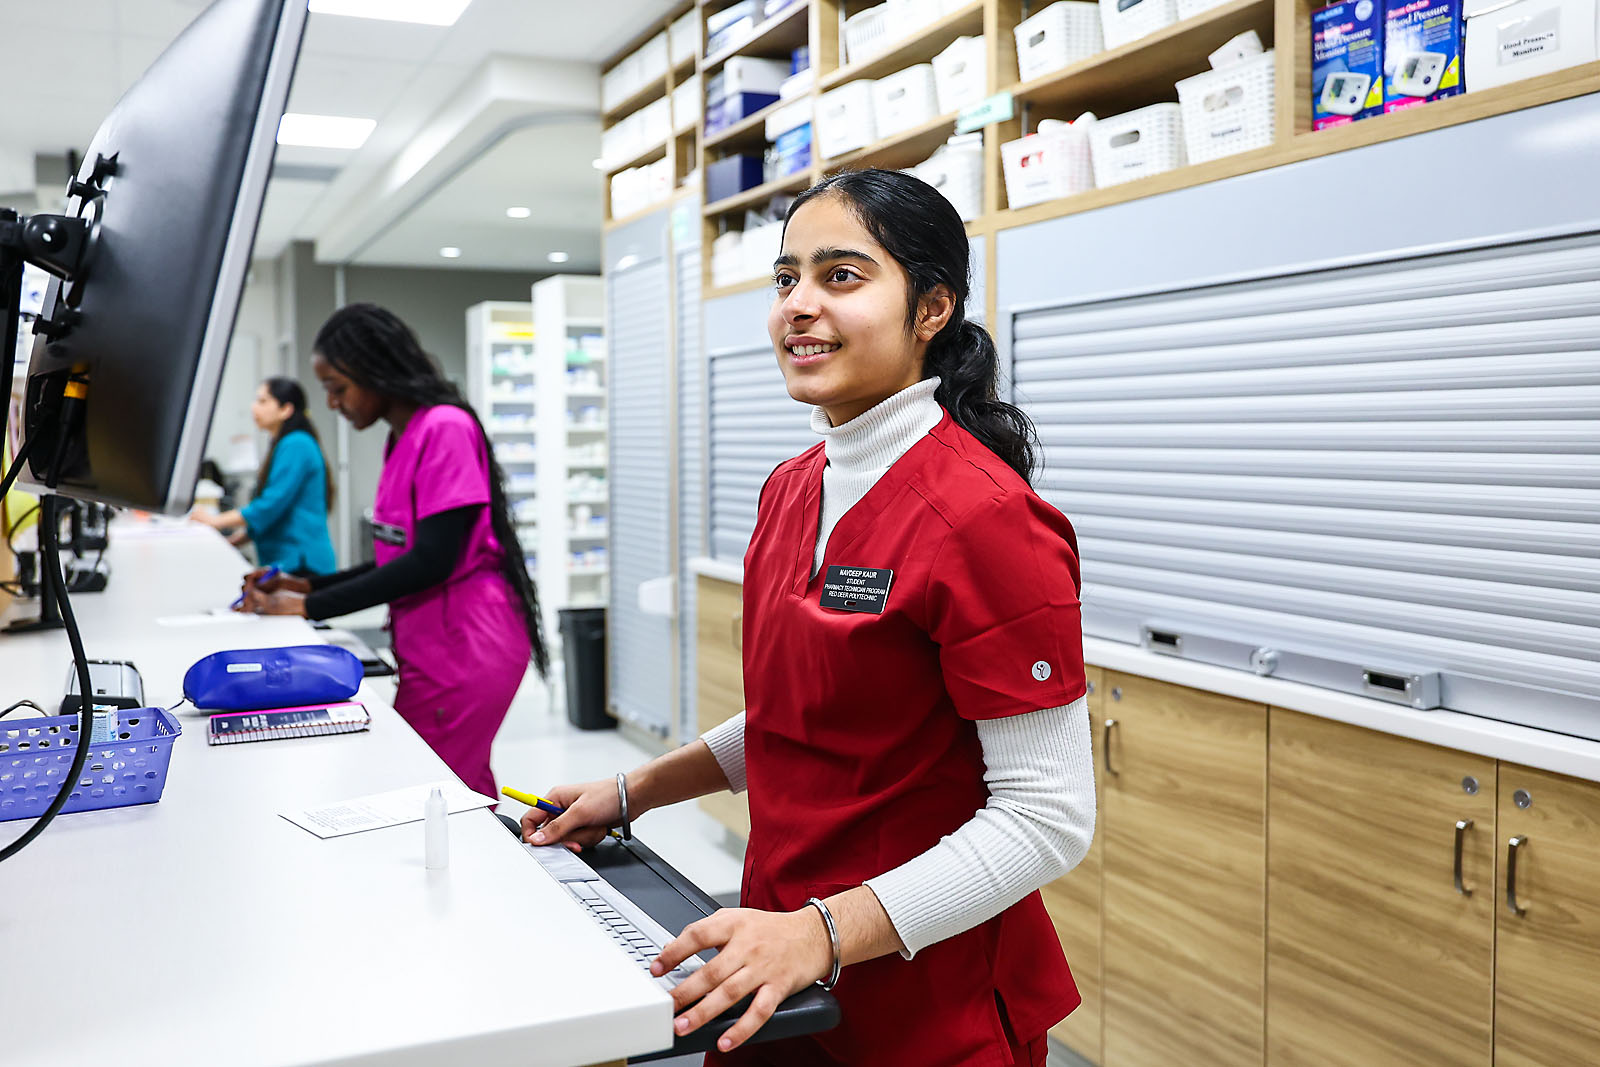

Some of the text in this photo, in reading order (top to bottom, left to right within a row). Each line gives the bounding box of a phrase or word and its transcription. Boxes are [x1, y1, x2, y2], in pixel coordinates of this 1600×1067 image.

[1413, 4, 1449, 22] Pressure
[1512, 46, 1544, 57] Monitors
[846, 578, 866, 586] STUDENT
[844, 585, 866, 593] TECHNICIAN
[866, 587, 886, 595] PROGRAM
[848, 593, 878, 601] POLYTECHNIC
